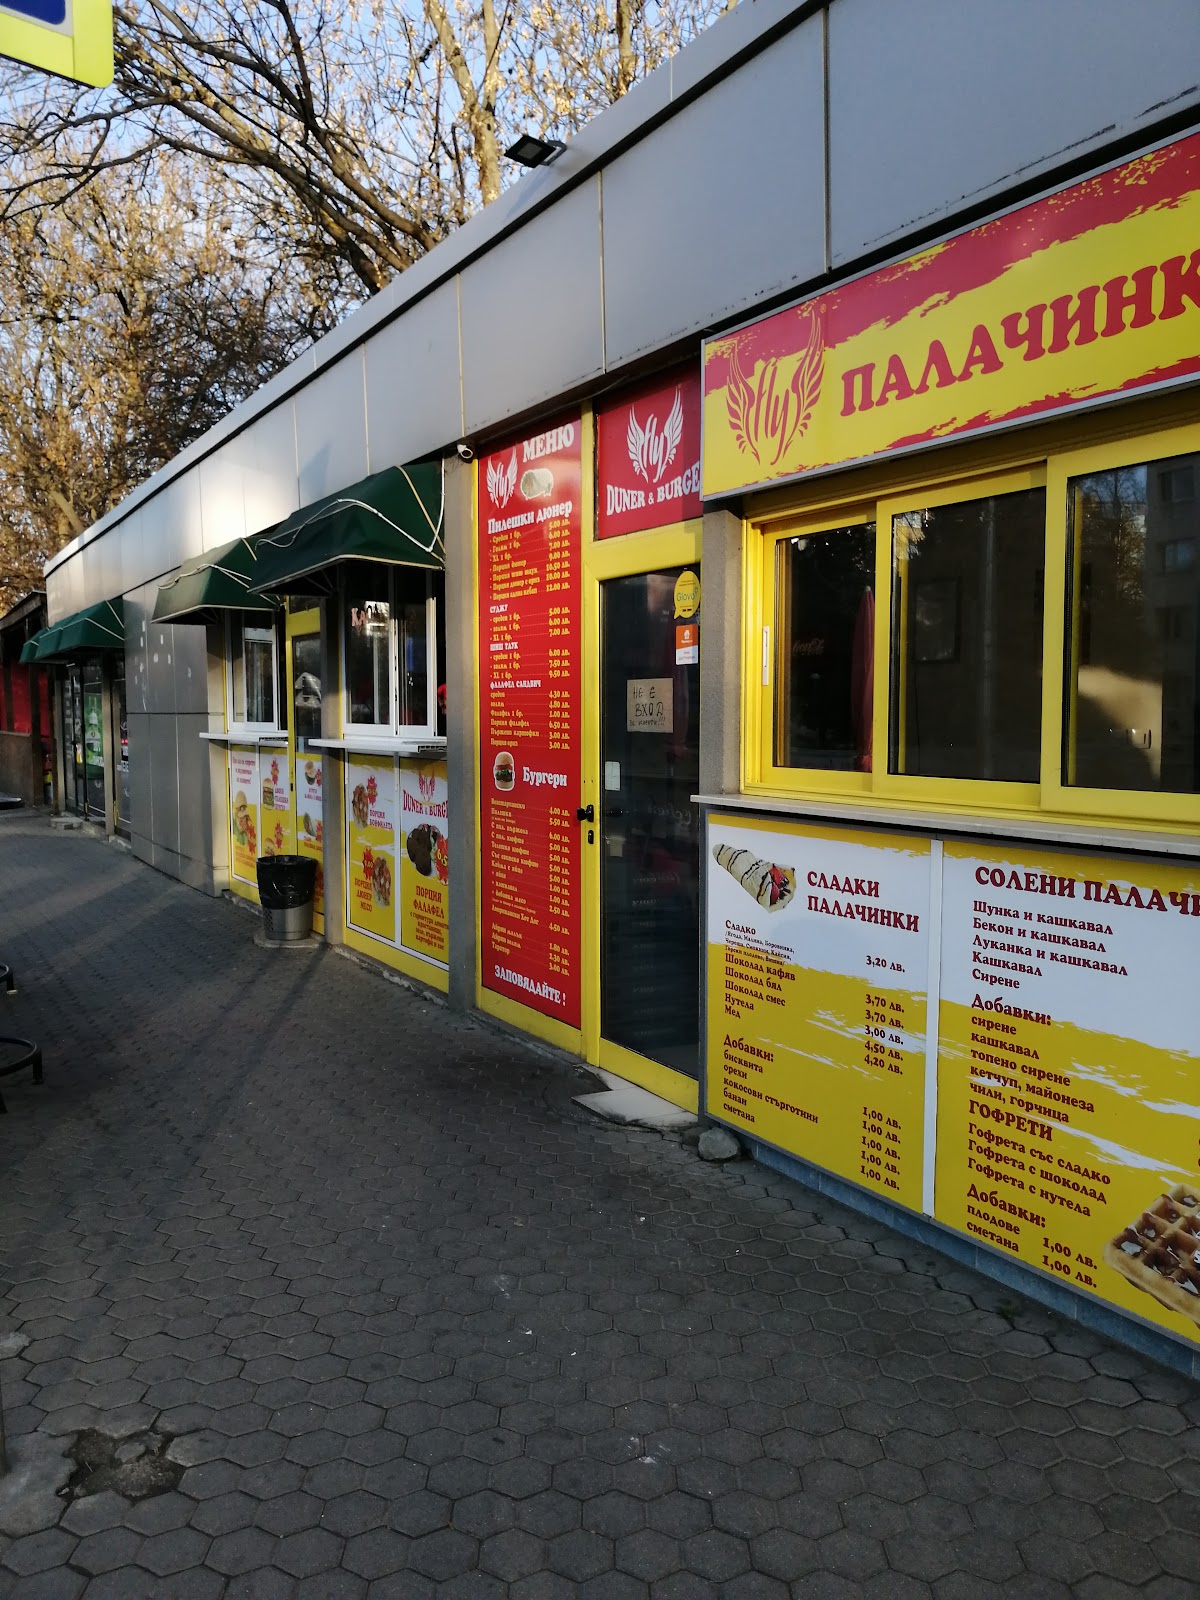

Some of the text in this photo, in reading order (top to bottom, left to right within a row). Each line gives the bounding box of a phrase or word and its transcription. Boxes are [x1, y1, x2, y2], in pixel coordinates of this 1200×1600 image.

[841, 250, 1200, 417] ПАЛАЧИНК
[523, 423, 574, 463] МЕНЮ
[607, 461, 700, 516] DUNER & BURGE
[488, 501, 573, 535] Пилешки дюнер
[549, 520, 561, 531] 5.00
[549, 530, 561, 540] 6.00
[549, 541, 561, 551] 7.00
[546, 562, 561, 571] 10.50
[549, 552, 561, 562] 9.00
[546, 572, 561, 581] 10.00
[546, 583, 561, 592] 12.00
[549, 607, 561, 617] 5.00
[549, 618, 561, 626] 6.00
[549, 628, 561, 638] 7.00
[549, 660, 561, 668] 7.50
[549, 690, 561, 699] 4.30
[523, 766, 568, 789] Бургери
[416, 885, 442, 903] ПОРЦИЯ
[807, 871, 880, 898] СЛАДКИ
[975, 866, 1076, 899] СОЛЕНИ
[807, 895, 920, 933] ПАЛАЧИНКИ
[973, 900, 1113, 935] Шунка и кашкавал
[725, 920, 756, 935] Сладко
[973, 917, 1106, 953] Бекон и кашкавал
[725, 953, 796, 981] Шоколад кафяв
[866, 955, 906, 973] 3,20 лв.
[973, 935, 1128, 976] Луканка и кашкавал
[973, 951, 1043, 977] Кашкавал
[725, 966, 782, 992] Шоколад бял
[972, 968, 1020, 989] Сирене
[725, 979, 786, 1007] Шоколад смес
[725, 993, 754, 1011] Нутела
[866, 994, 905, 1014] 3,70 лв.
[724, 1004, 741, 1019] Мед
[865, 1010, 904, 1029] 3,70 лв.
[972, 994, 1052, 1026] Добавки:
[864, 1025, 904, 1045] 3,00 лв.
[972, 1016, 1017, 1035] сирене
[724, 1034, 774, 1063] Добавки:
[864, 1040, 904, 1061] 4,50 лв.
[971, 1032, 1040, 1060] кашкавал
[724, 1050, 763, 1074] бисквита
[724, 1064, 748, 1080] орехи
[864, 1055, 903, 1076] 4,20 лв.
[971, 1049, 1071, 1087] топено сирене
[724, 1088, 747, 1107] банан
[724, 1078, 819, 1124] кокосови стърготини
[970, 1065, 1095, 1113] кетчуп, майонеза
[724, 1103, 755, 1124] сметана
[970, 1083, 1070, 1124] чили, горчица
[863, 1106, 901, 1130] 1,00 лв.
[969, 1100, 1053, 1142] ГОФРЕТИ
[862, 1120, 901, 1144] 1,00 лв.
[862, 1136, 901, 1160] 1,00 лв.
[969, 1123, 1111, 1186] Гофрета със сладко
[861, 1151, 900, 1175] 1,00 лв.
[968, 1139, 1107, 1205] Гофрета с шоколад
[860, 1165, 900, 1191] 1,00 лв.
[968, 1157, 1091, 1217] Гофрета с нутела
[967, 1184, 1046, 1228] Добавки:
[967, 1204, 1021, 1235] плодове
[967, 1221, 1020, 1252] сметана
[1043, 1237, 1098, 1270] 1,00 лв.
[1042, 1255, 1097, 1289] 1,00 лв.
